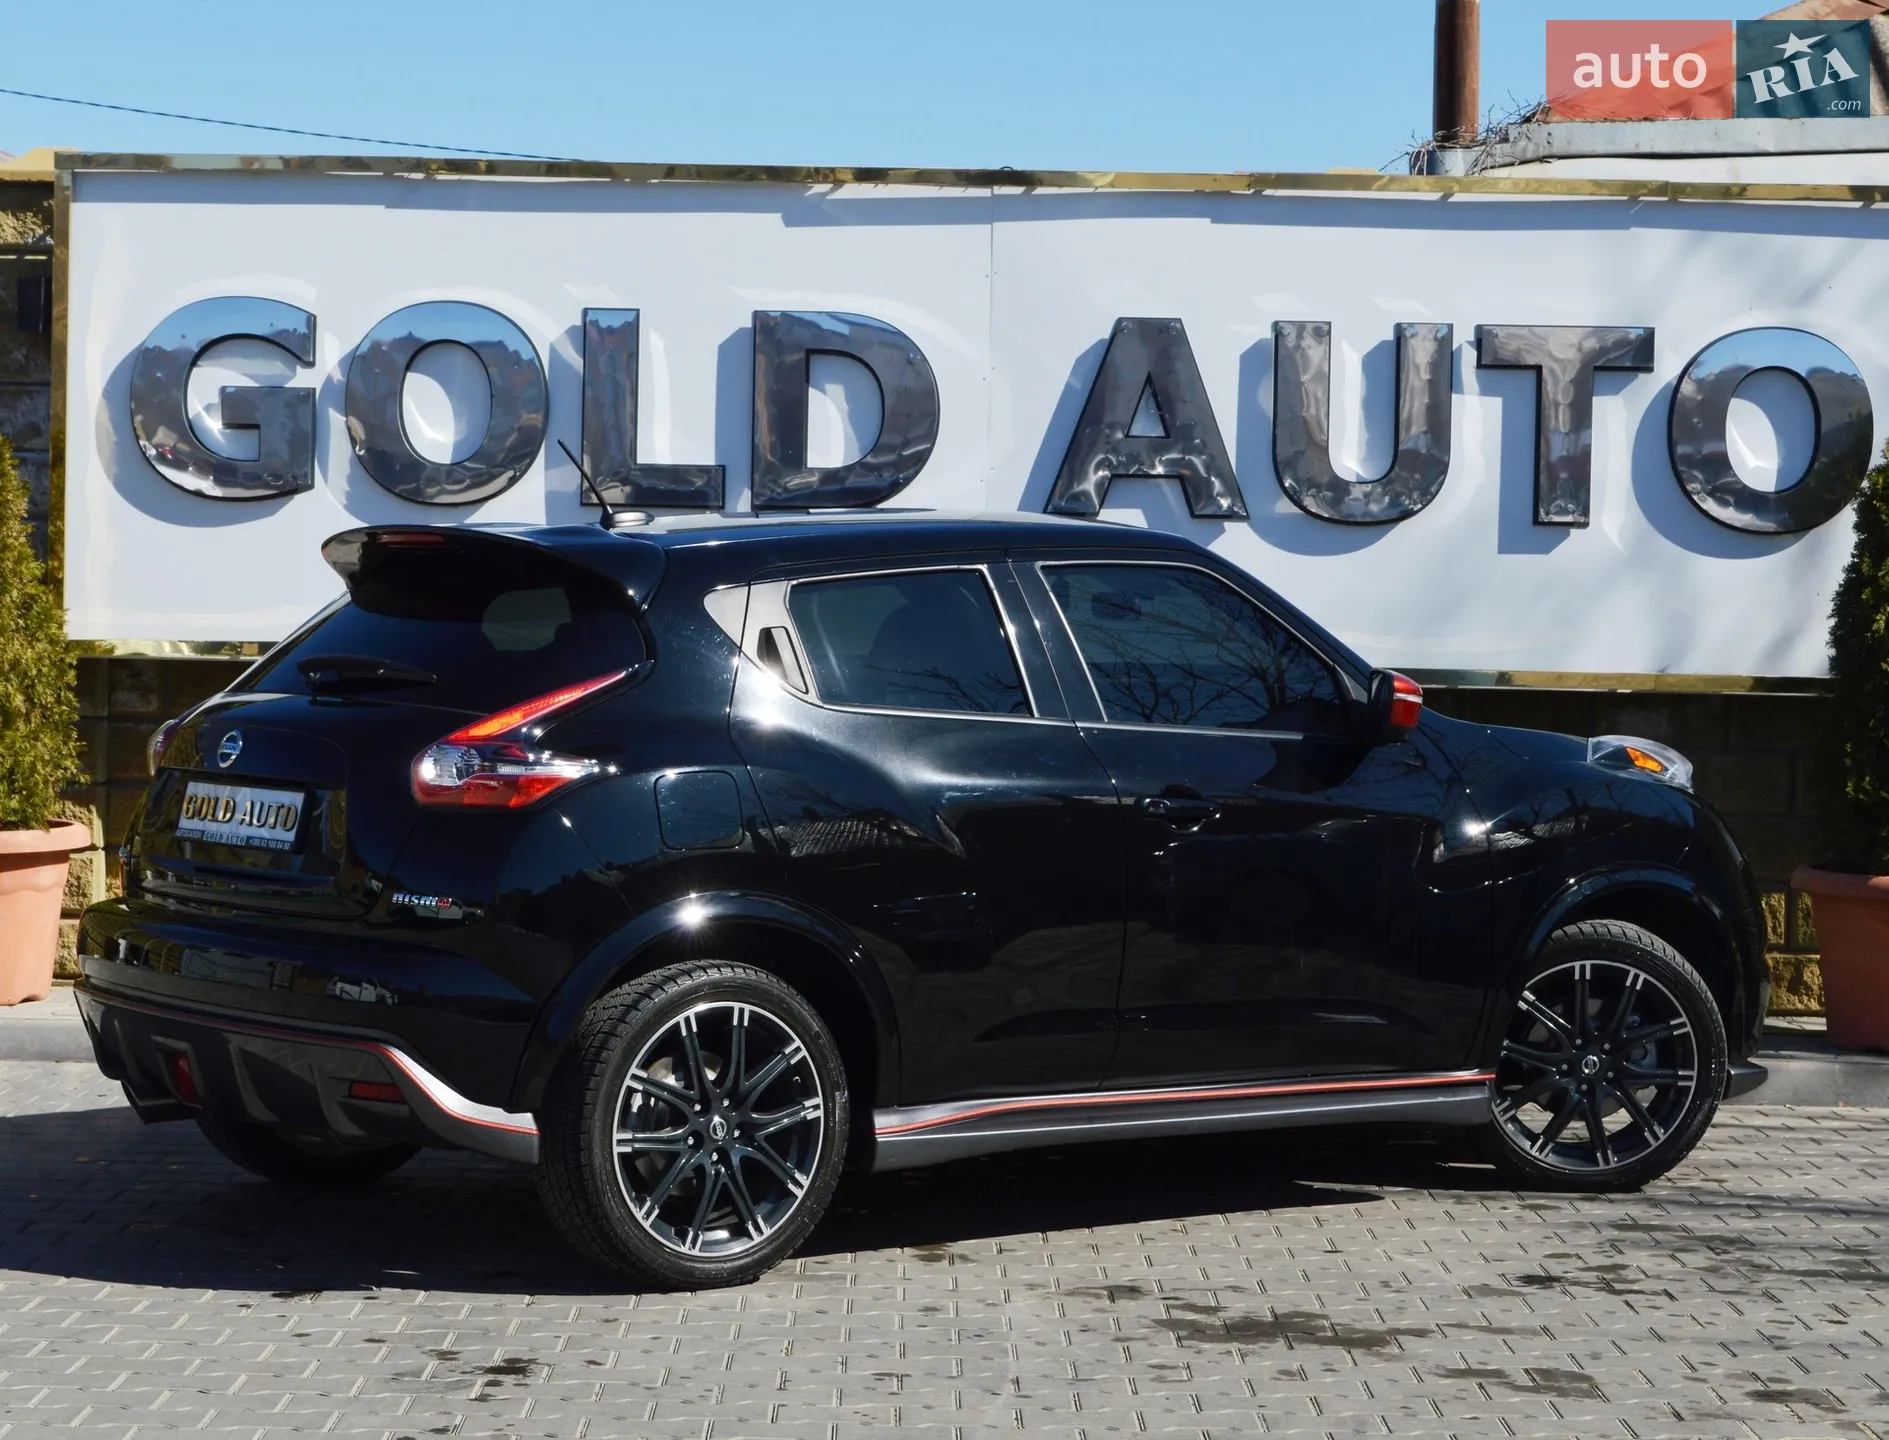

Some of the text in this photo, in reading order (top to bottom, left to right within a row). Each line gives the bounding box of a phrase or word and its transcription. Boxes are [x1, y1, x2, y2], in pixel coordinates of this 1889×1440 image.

[130, 296, 1874, 536] GOLD AUTO
[183, 794, 298, 832] GOLD AUTO
[205, 832, 224, 842] GOLD
[226, 834, 245, 845] AUTO
